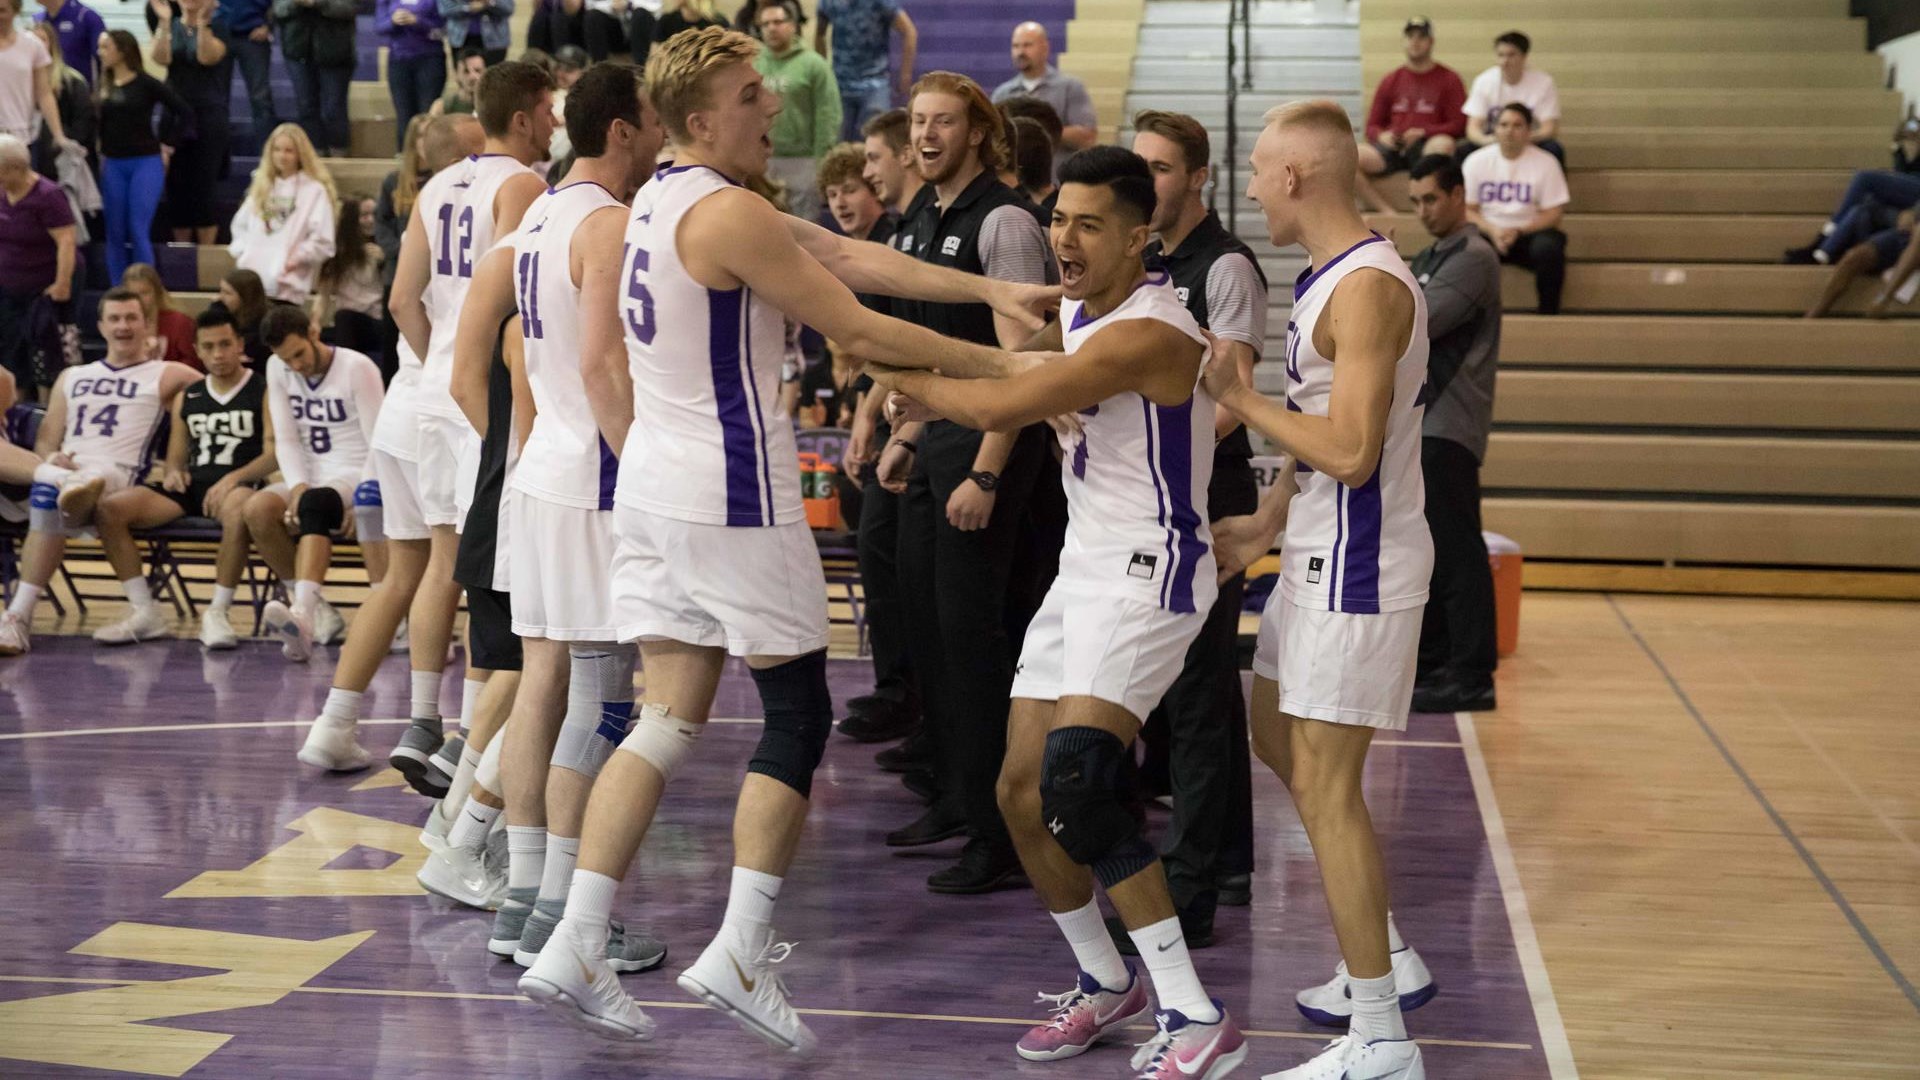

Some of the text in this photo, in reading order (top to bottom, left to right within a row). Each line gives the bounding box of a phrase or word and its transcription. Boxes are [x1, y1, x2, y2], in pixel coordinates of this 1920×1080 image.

[1478, 181, 1531, 203] GCU
[436, 203, 473, 278] 12
[518, 251, 544, 339] 11
[71, 378, 138, 398] GCU
[73, 403, 120, 437] 14
[187, 410, 254, 437] GCU
[196, 434, 242, 466] 17
[309, 426, 332, 454] 8
